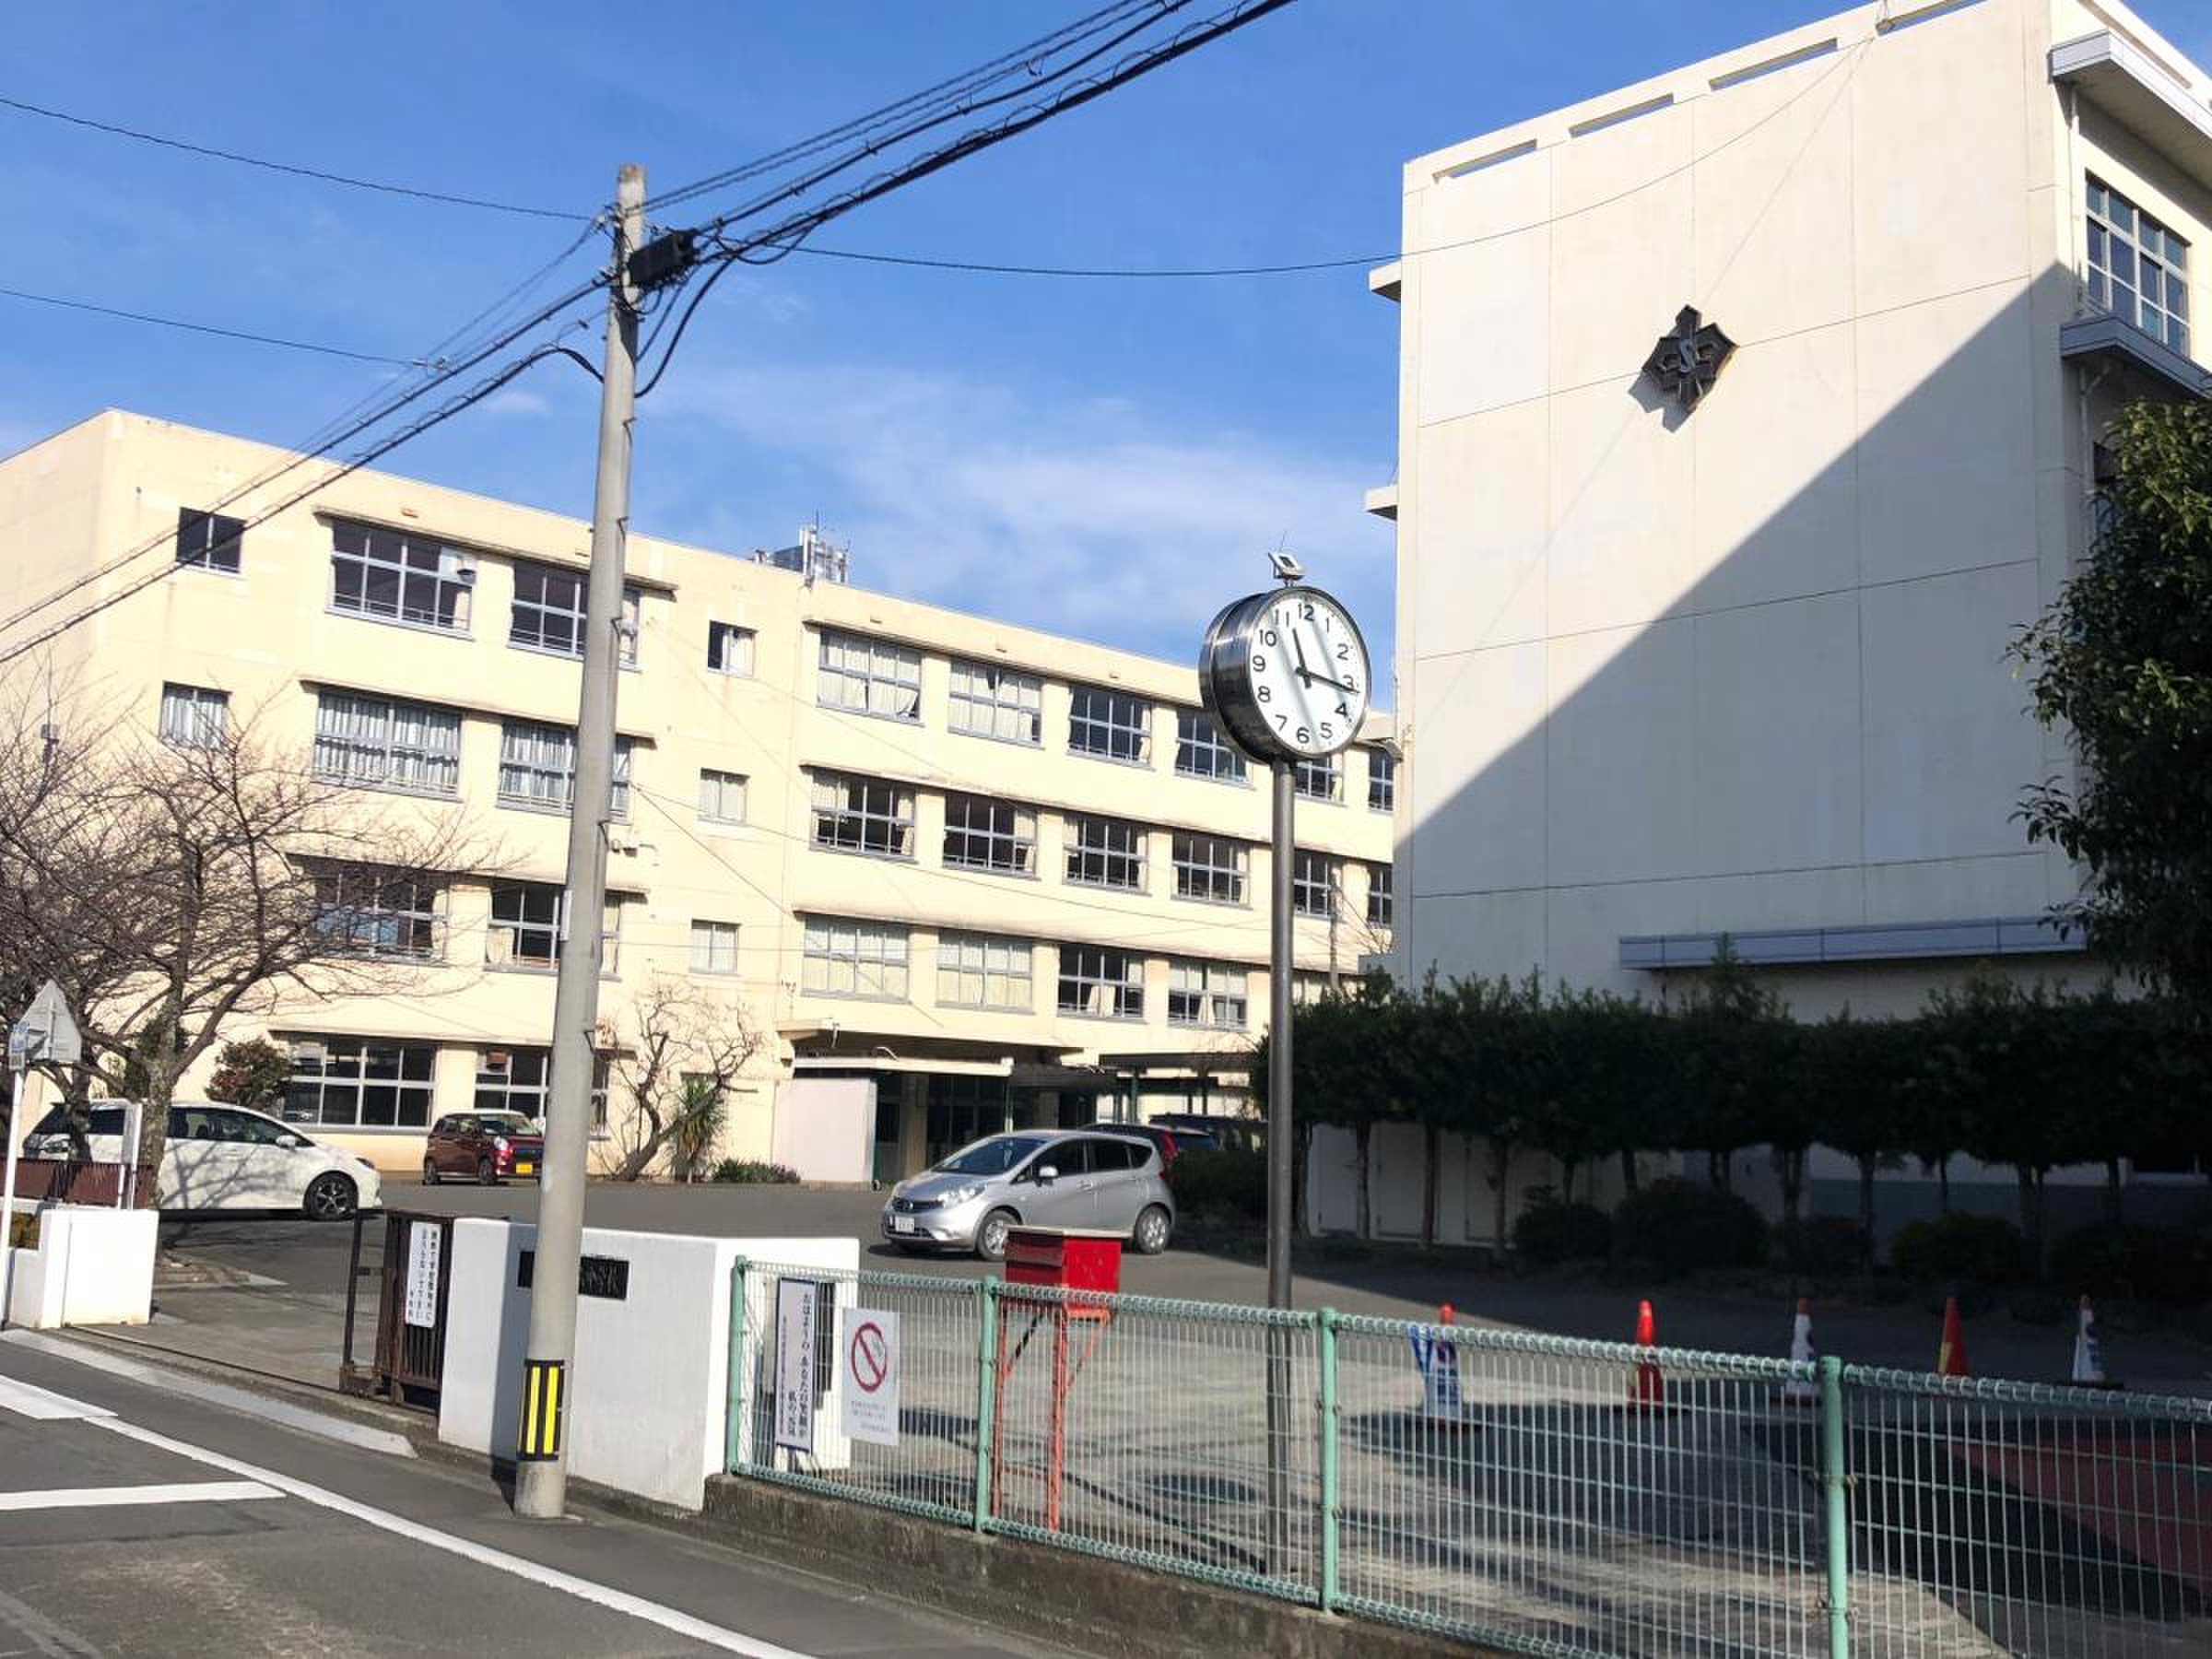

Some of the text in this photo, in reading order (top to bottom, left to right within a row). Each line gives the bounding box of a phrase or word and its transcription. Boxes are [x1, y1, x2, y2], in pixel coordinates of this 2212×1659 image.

[1274, 609, 1290, 628] 11
[1298, 604, 1314, 622] 12
[1259, 629, 1277, 647] 10
[1336, 643, 1349, 661] 2
[1253, 655, 1266, 672] 9
[1342, 674, 1355, 691] 3
[1257, 686, 1271, 703] 8
[1335, 701, 1348, 718] 4
[1275, 714, 1288, 731] 7
[1320, 722, 1333, 739] 5
[1296, 727, 1310, 744] 6
